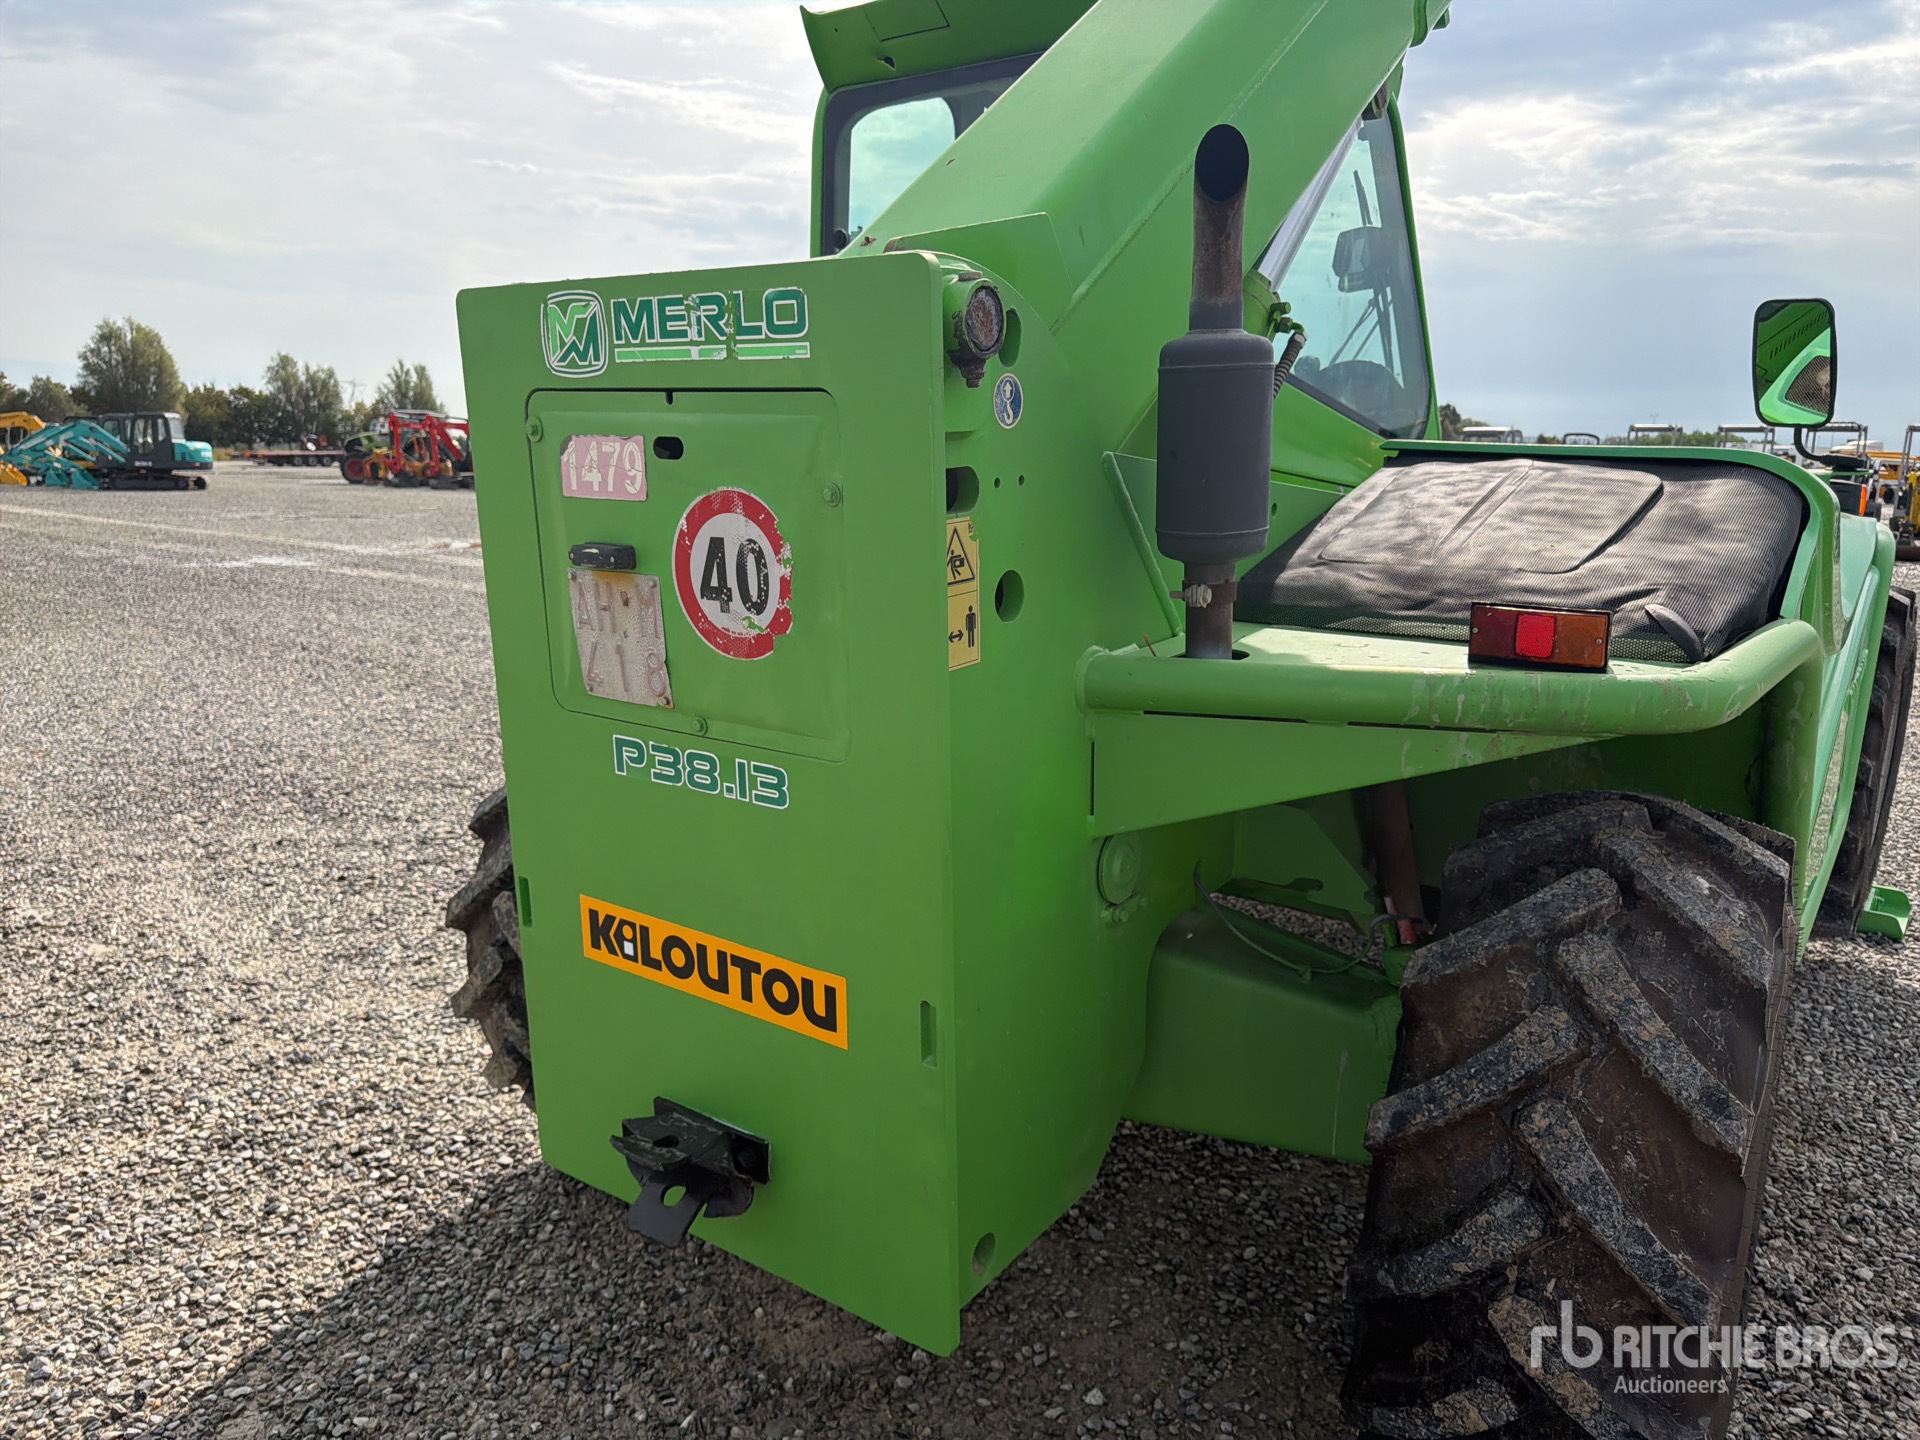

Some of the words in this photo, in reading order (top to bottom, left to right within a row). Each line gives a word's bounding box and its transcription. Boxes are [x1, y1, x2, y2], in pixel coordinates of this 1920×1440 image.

[611, 287, 809, 343] MERLO
[563, 440, 643, 494] 1479
[700, 536, 770, 616] 40
[612, 734, 790, 810] P38.13
